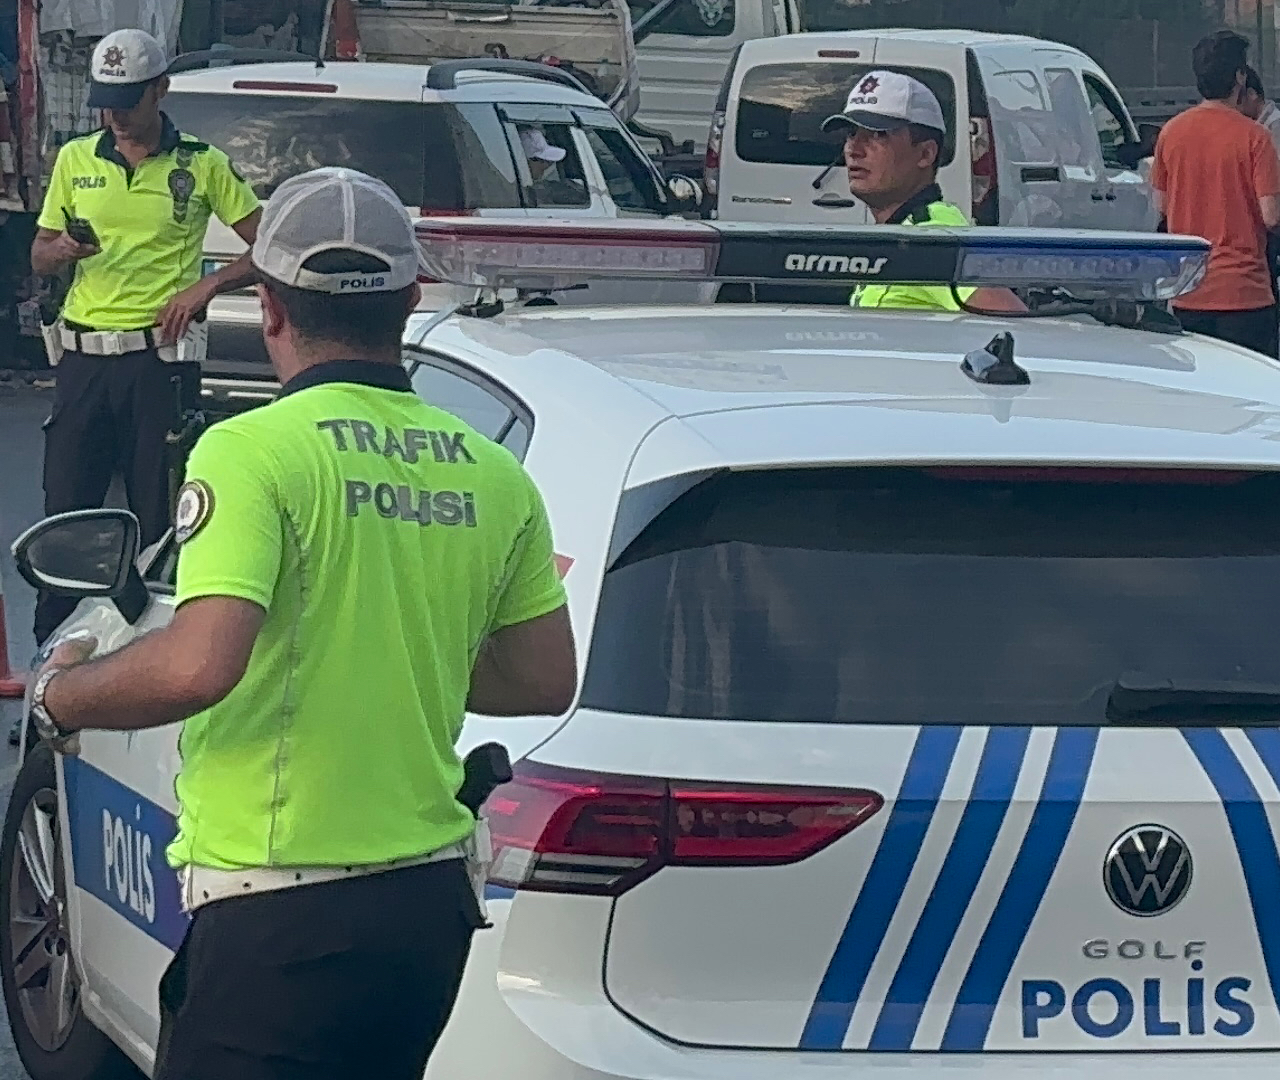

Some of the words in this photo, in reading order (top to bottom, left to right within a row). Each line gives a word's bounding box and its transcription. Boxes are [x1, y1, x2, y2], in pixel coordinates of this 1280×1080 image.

[785, 253, 888, 275] armas
[103, 803, 156, 925] POLİS
[1082, 940, 1207, 960] GOLF
[1022, 958, 1255, 1039] POLİS
